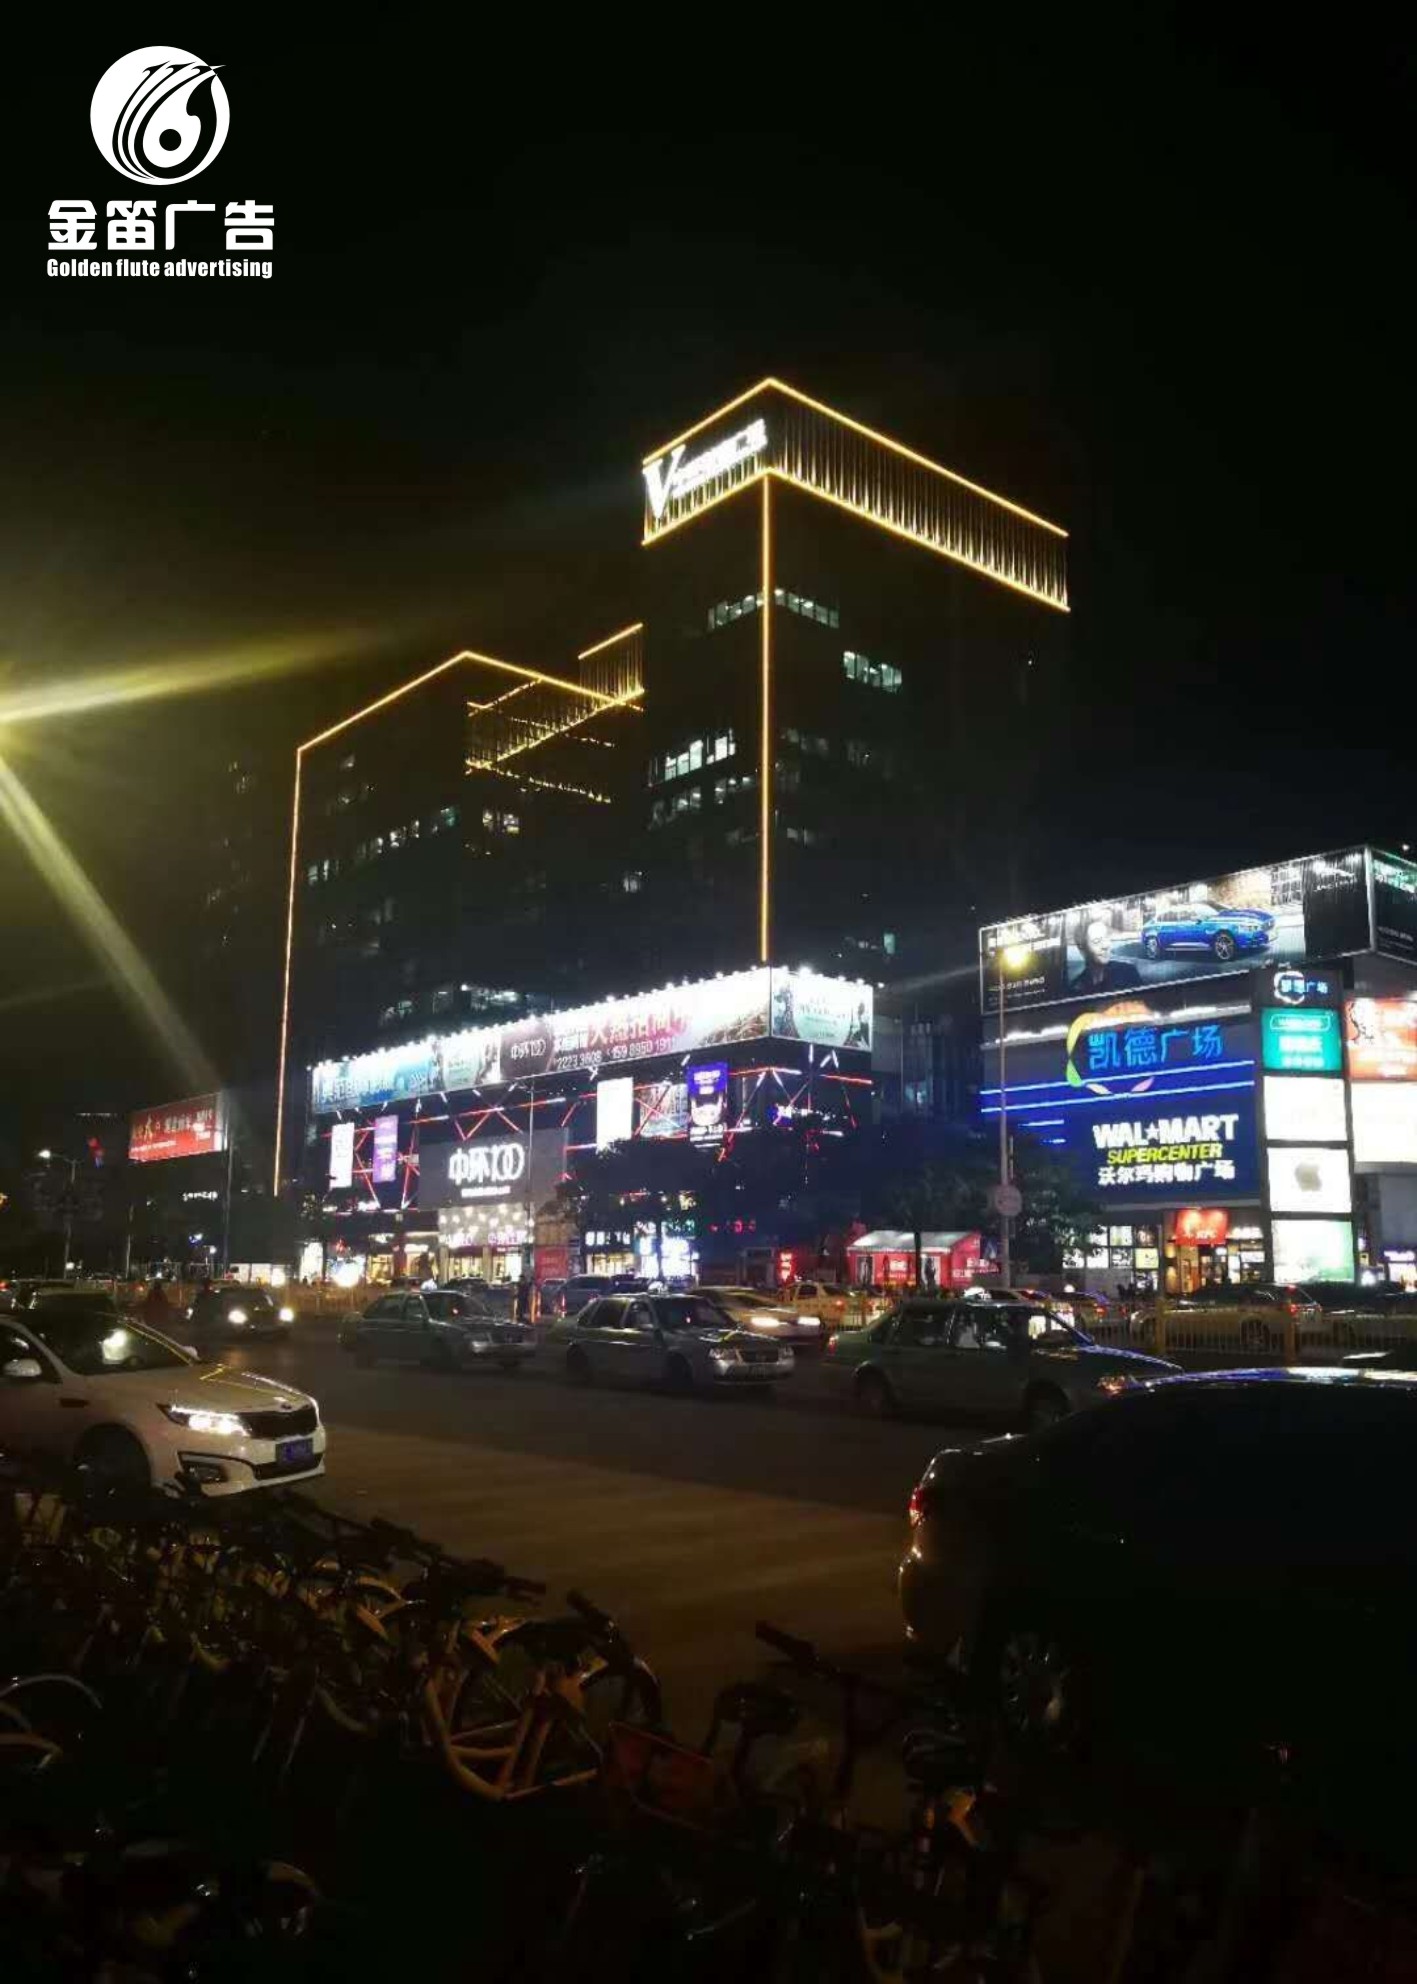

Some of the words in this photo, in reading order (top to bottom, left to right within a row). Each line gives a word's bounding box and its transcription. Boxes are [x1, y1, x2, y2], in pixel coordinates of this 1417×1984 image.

[1089, 1024, 1223, 1070] 凯德广场
[1107, 1143, 1223, 1164] SUPERCENTER
